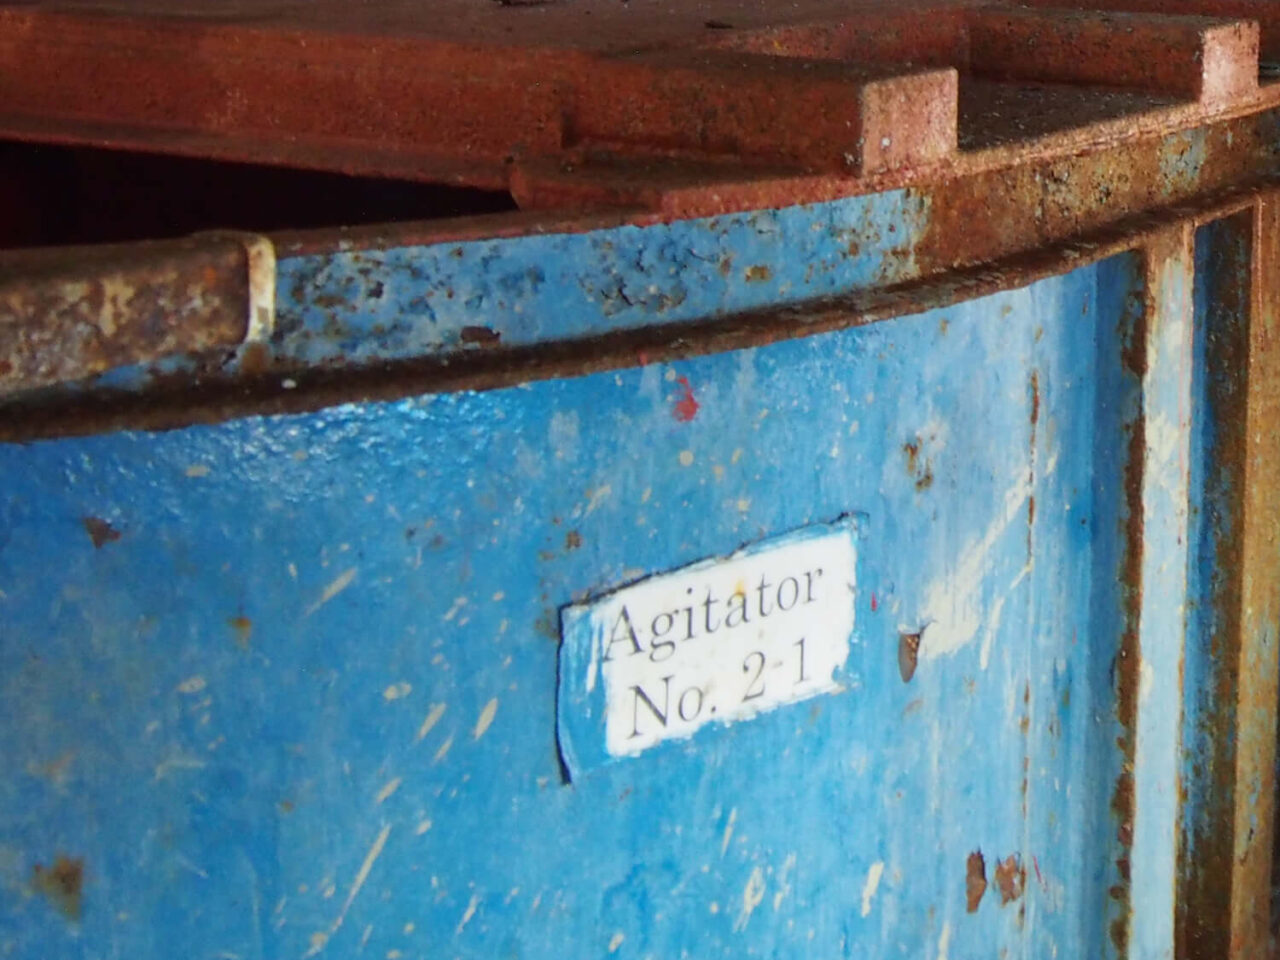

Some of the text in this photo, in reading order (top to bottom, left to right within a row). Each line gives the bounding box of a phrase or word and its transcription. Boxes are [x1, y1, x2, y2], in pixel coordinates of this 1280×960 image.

[602, 567, 823, 663] Agitator
[627, 636, 812, 740] No. 2-1
